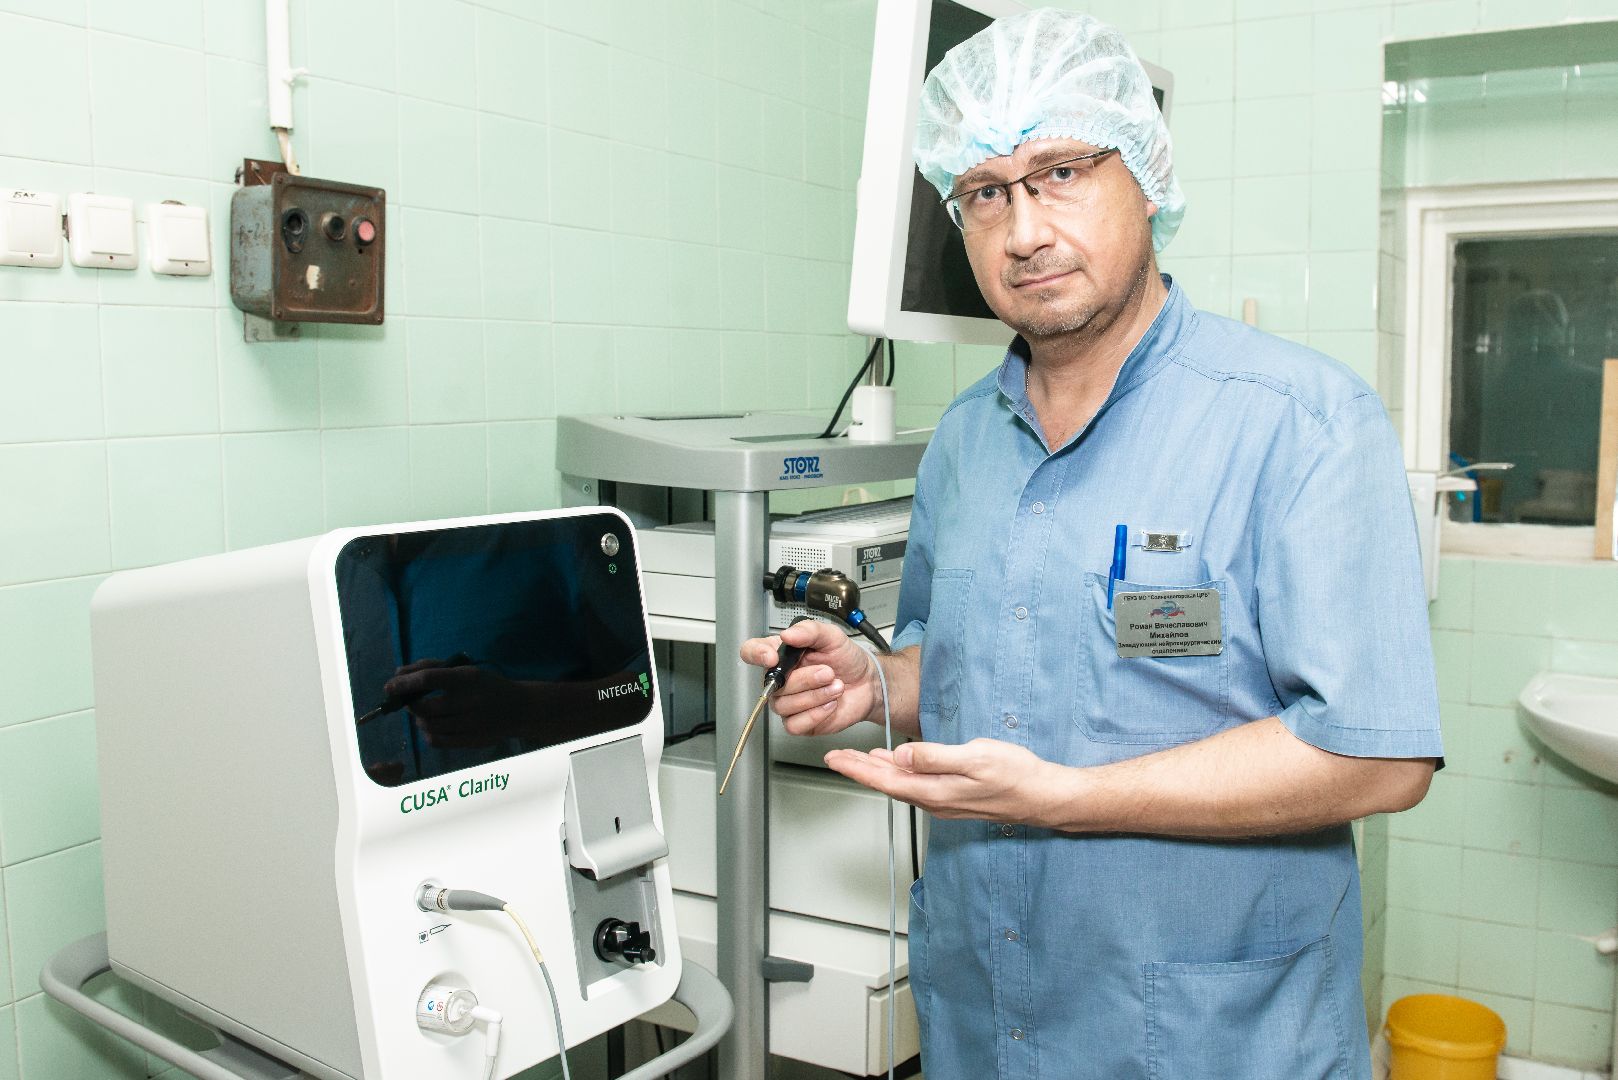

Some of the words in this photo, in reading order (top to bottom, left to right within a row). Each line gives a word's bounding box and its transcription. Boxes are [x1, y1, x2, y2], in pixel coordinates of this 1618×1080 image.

[783, 456, 820, 475] STORZ
[863, 546, 881, 560] STORZ
[1154, 621, 1208, 629] Вячеславович
[1149, 631, 1189, 639] Михайлов
[458, 773, 510, 798] Clarity
